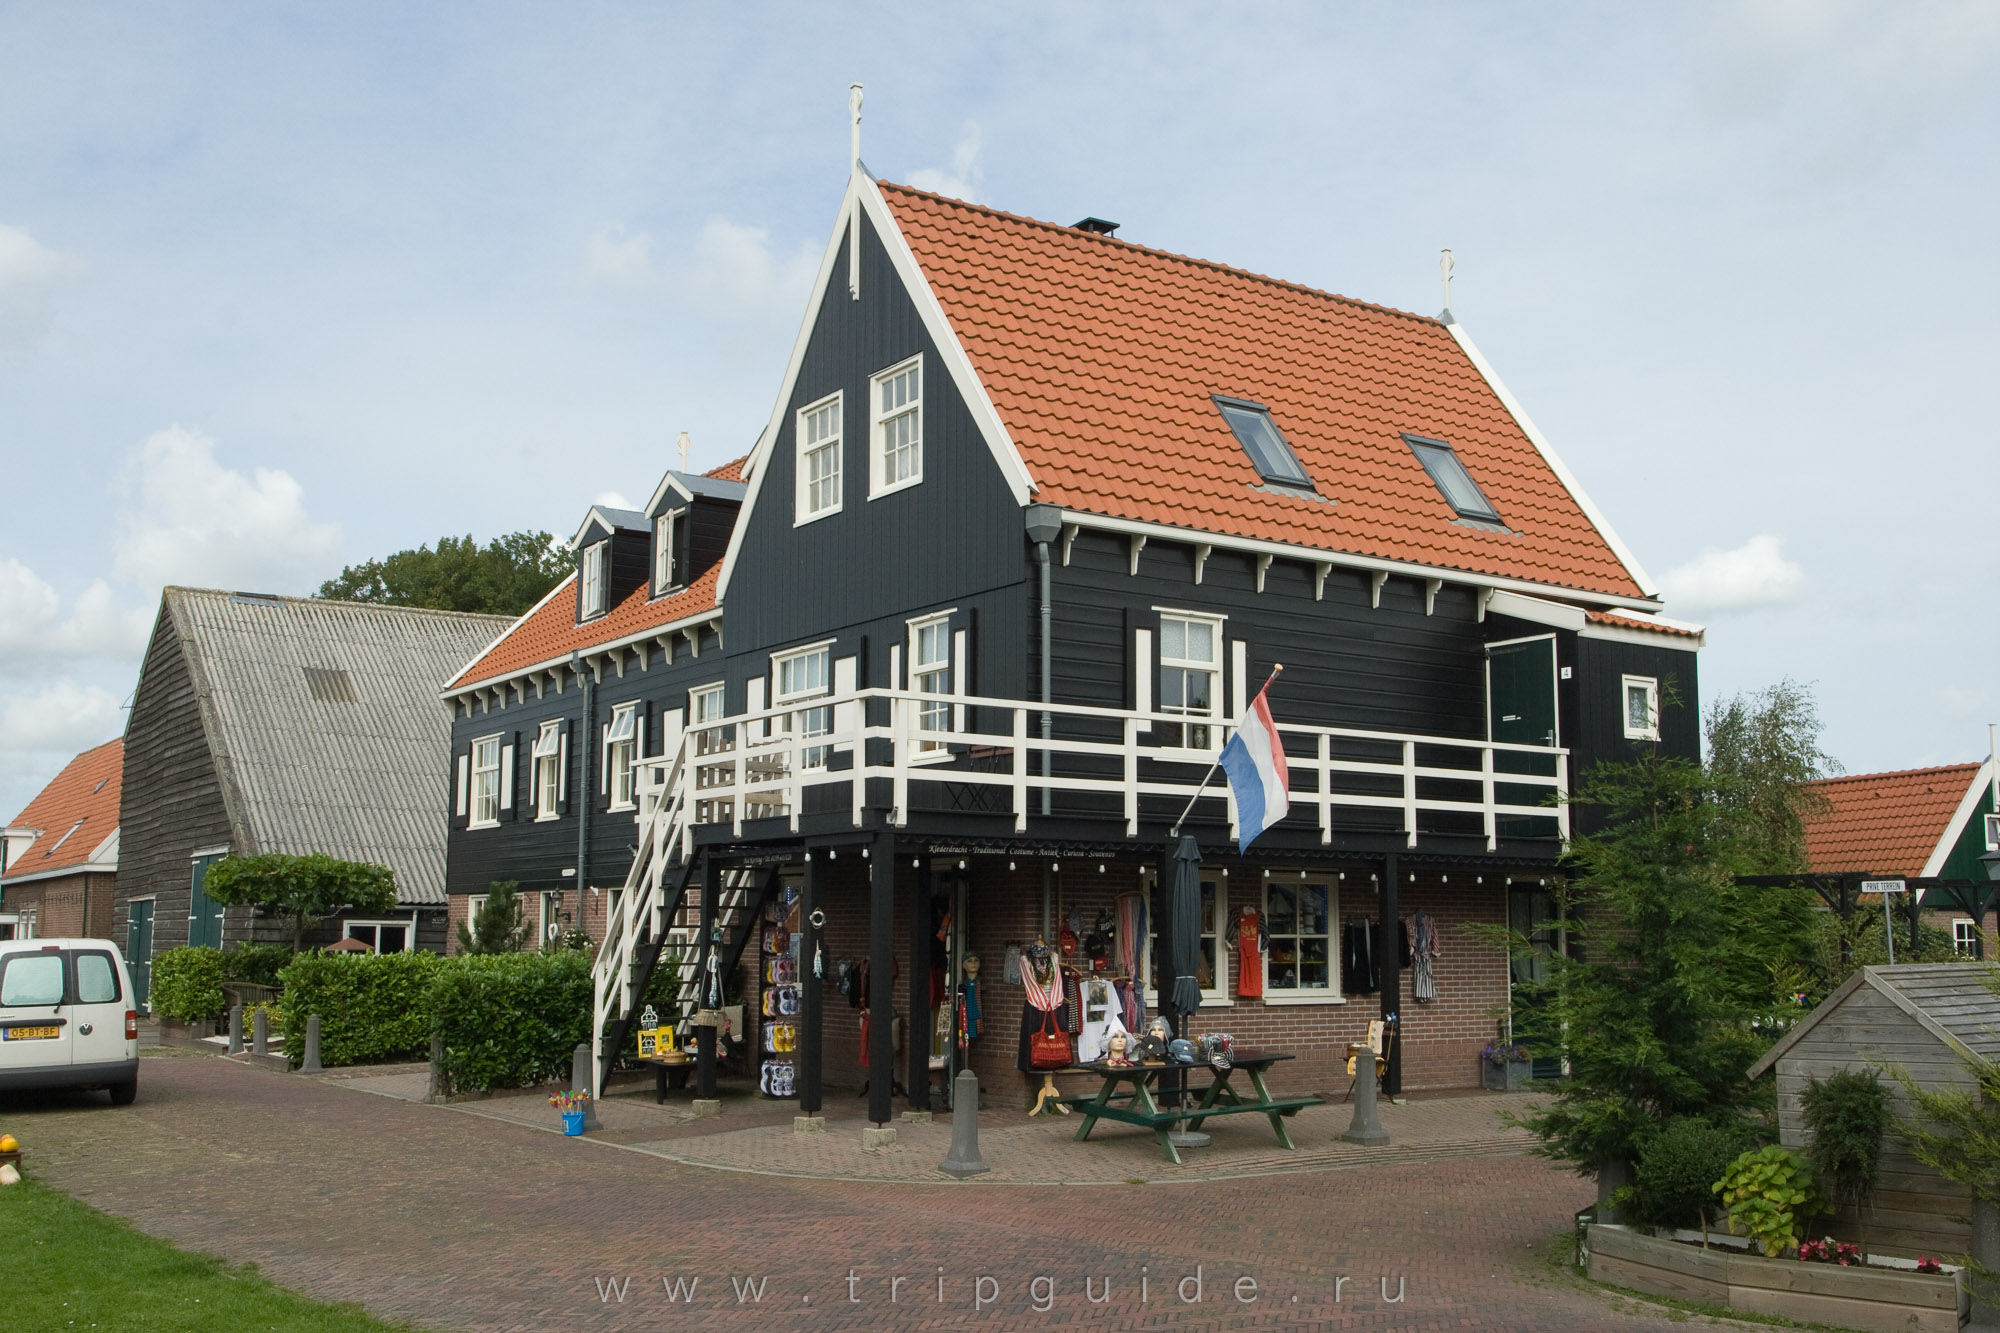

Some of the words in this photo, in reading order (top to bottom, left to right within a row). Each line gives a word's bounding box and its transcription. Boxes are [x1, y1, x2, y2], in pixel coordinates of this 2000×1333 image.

[972, 846, 1006, 855] Traditional
[1009, 847, 1034, 856] Costume
[1088, 850, 1116, 858] Souvenirs
[11, 1027, 56, 1037] 05-BT-BF
